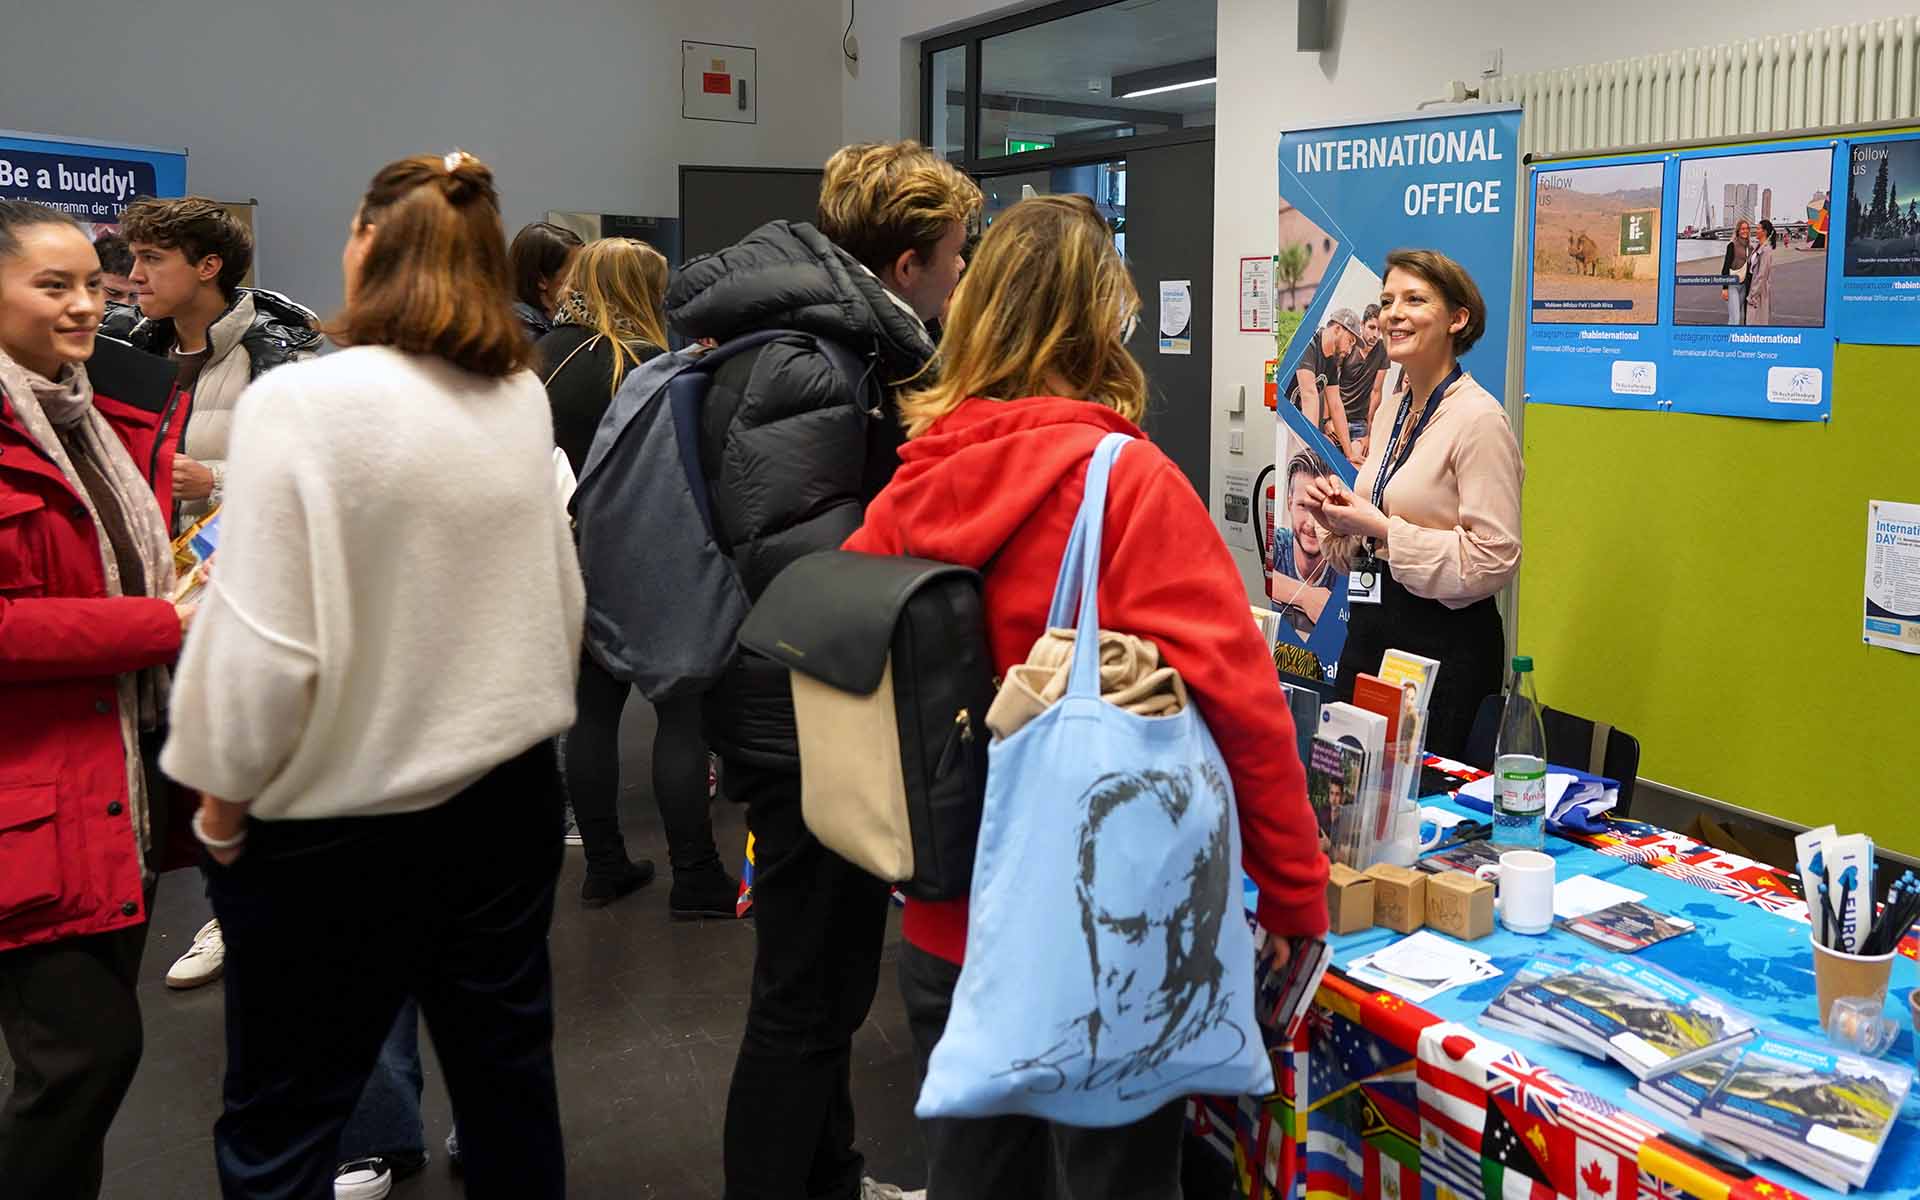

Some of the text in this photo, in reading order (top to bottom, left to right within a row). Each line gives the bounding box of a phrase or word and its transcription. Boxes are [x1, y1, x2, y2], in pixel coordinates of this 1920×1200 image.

[1297, 128, 1502, 173] INTERNATIONAL
[1853, 147, 1889, 161] follow
[1852, 164, 1867, 176] us
[0, 159, 136, 201] Be a buddy!
[1540, 175, 1573, 191] follow
[1404, 181, 1501, 216] OFFICE
[1538, 194, 1552, 207] us
[92, 202, 109, 216] der
[1876, 533, 1897, 545] DAY
